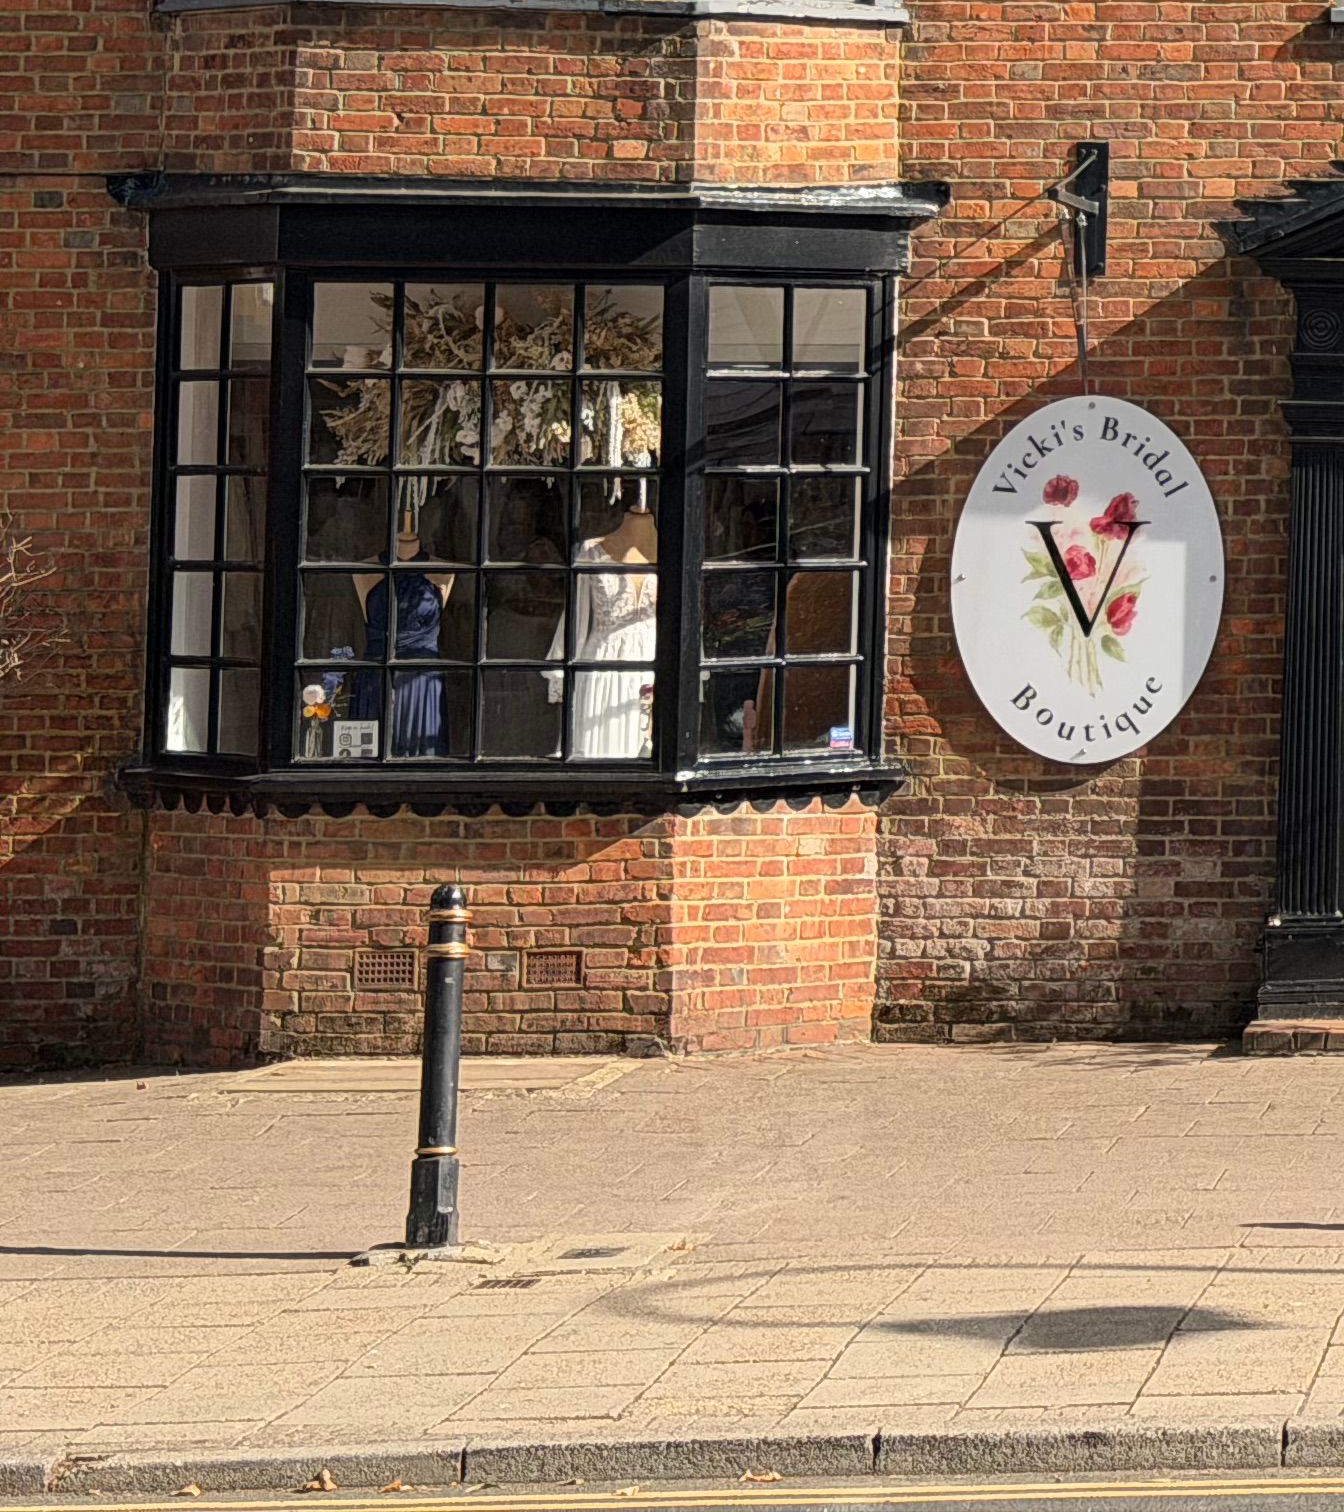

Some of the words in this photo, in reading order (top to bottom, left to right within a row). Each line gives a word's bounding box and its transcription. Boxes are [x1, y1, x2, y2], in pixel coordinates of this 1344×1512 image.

[992, 419, 1085, 495] Vicki's
[1100, 416, 1190, 498] Bridal
[1025, 521, 1152, 638] V
[1009, 676, 1165, 743] Boutique
